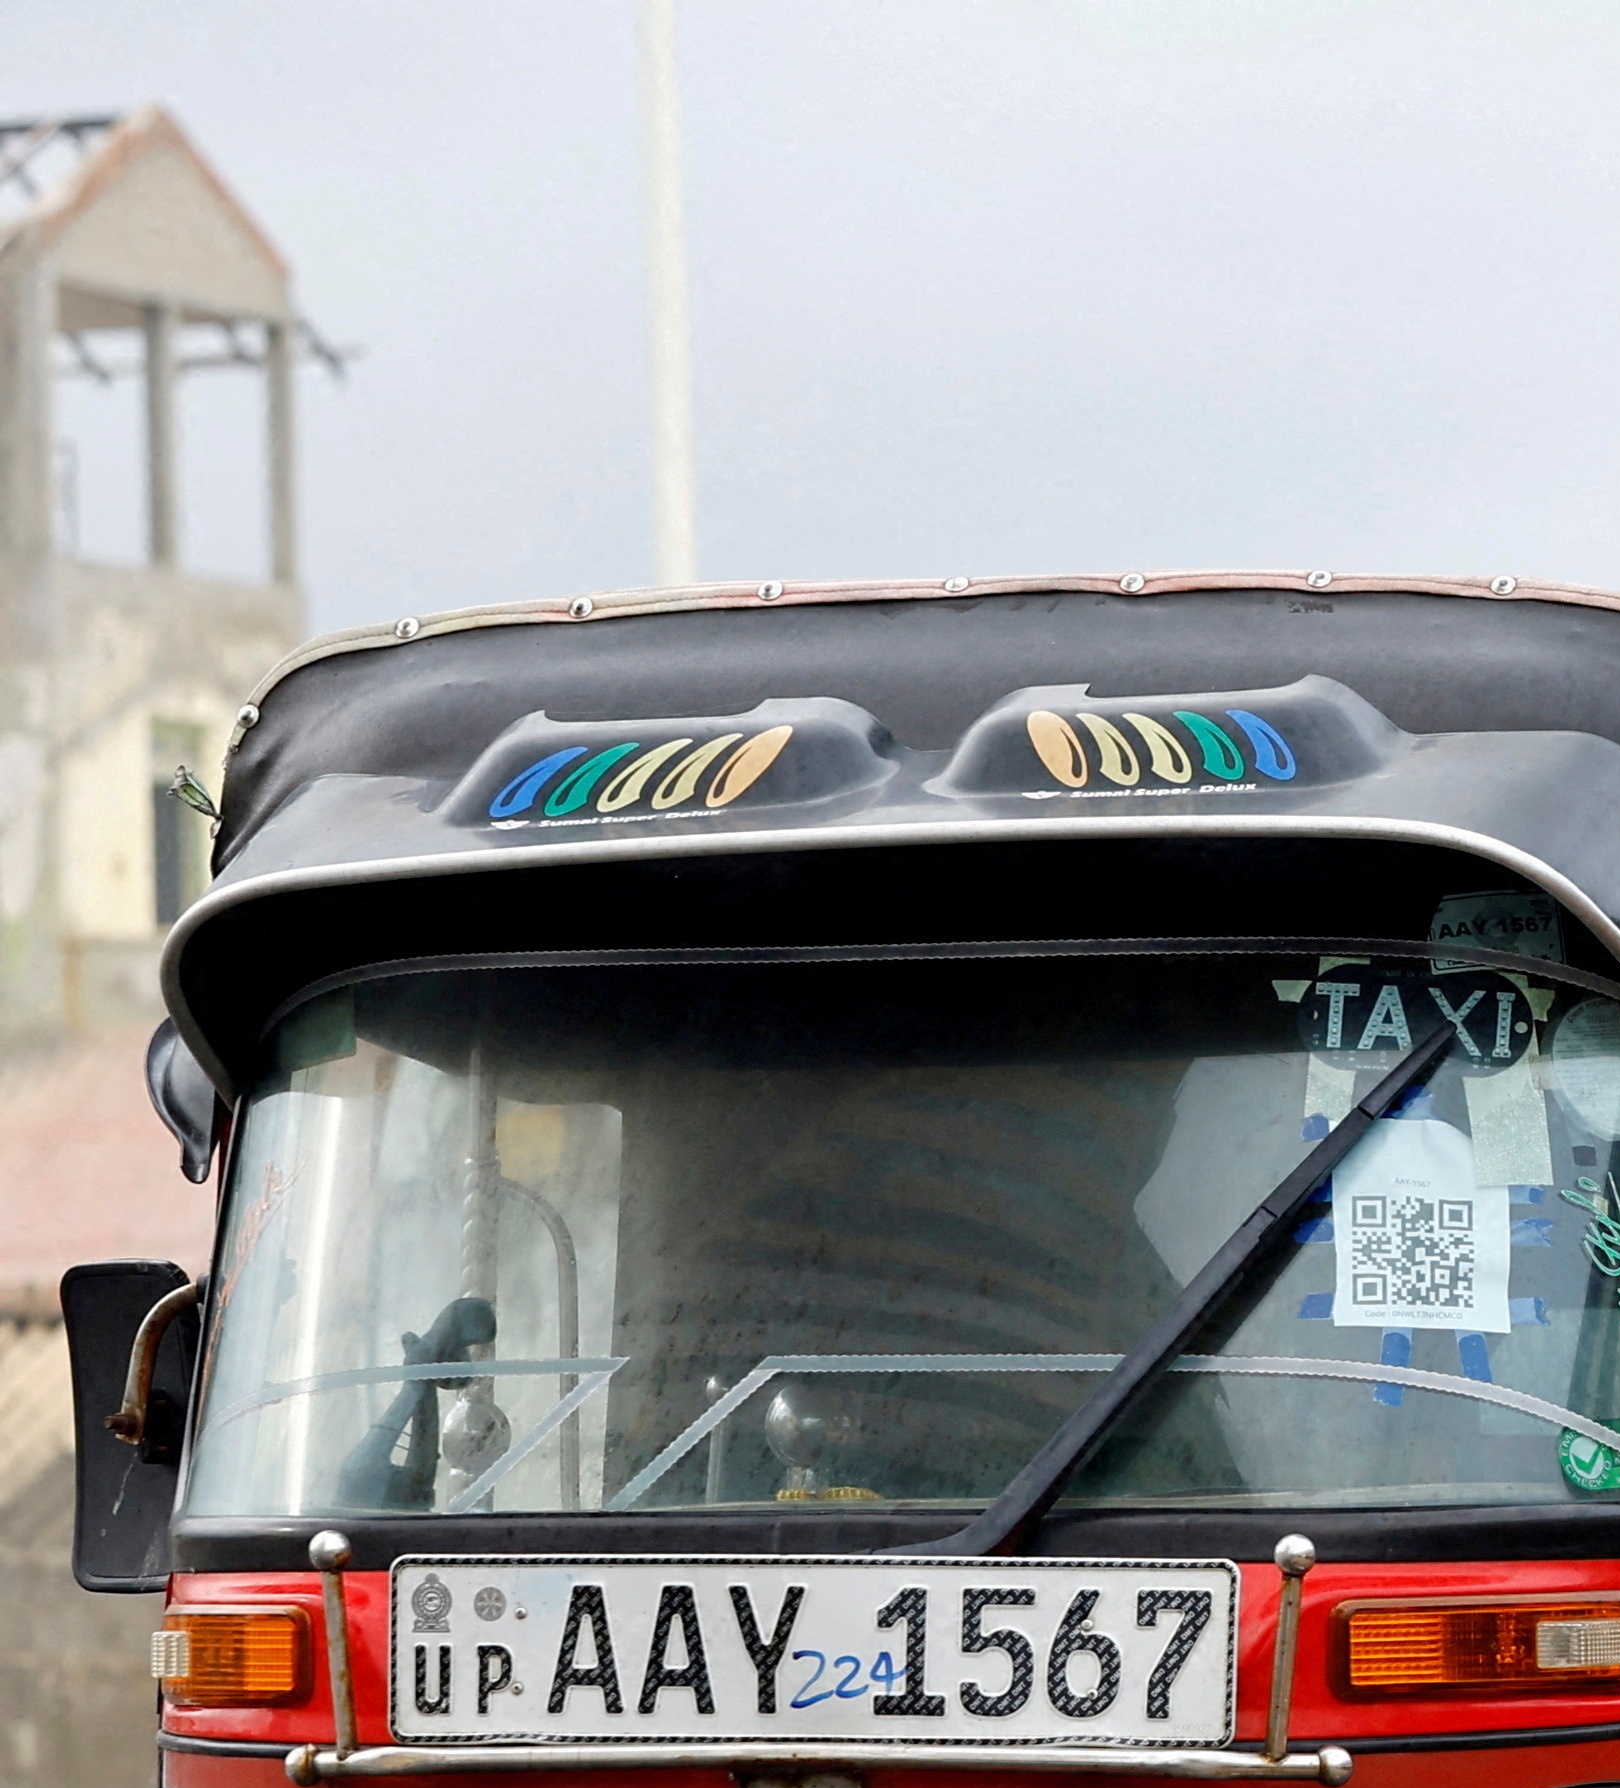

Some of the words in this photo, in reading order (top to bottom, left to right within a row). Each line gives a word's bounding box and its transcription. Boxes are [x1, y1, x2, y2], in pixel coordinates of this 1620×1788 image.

[1133, 786, 1191, 798] Super
[1199, 781, 1258, 793] Delux
[600, 814, 658, 824] Super
[664, 809, 722, 819] Delux
[1438, 918, 1488, 940] AAY
[1496, 916, 1552, 935] 1567
[1315, 981, 1516, 1059] TAXI
[1394, 1177, 1432, 1189] AAY-1567
[1364, 1310, 1387, 1319] Code
[1565, 1459, 1613, 1489] CHECKED
[547, 1584, 807, 1715] AAY
[873, 1585, 1213, 1721] 1567
[413, 1643, 513, 1715] UP
[789, 1649, 911, 1709] 224
